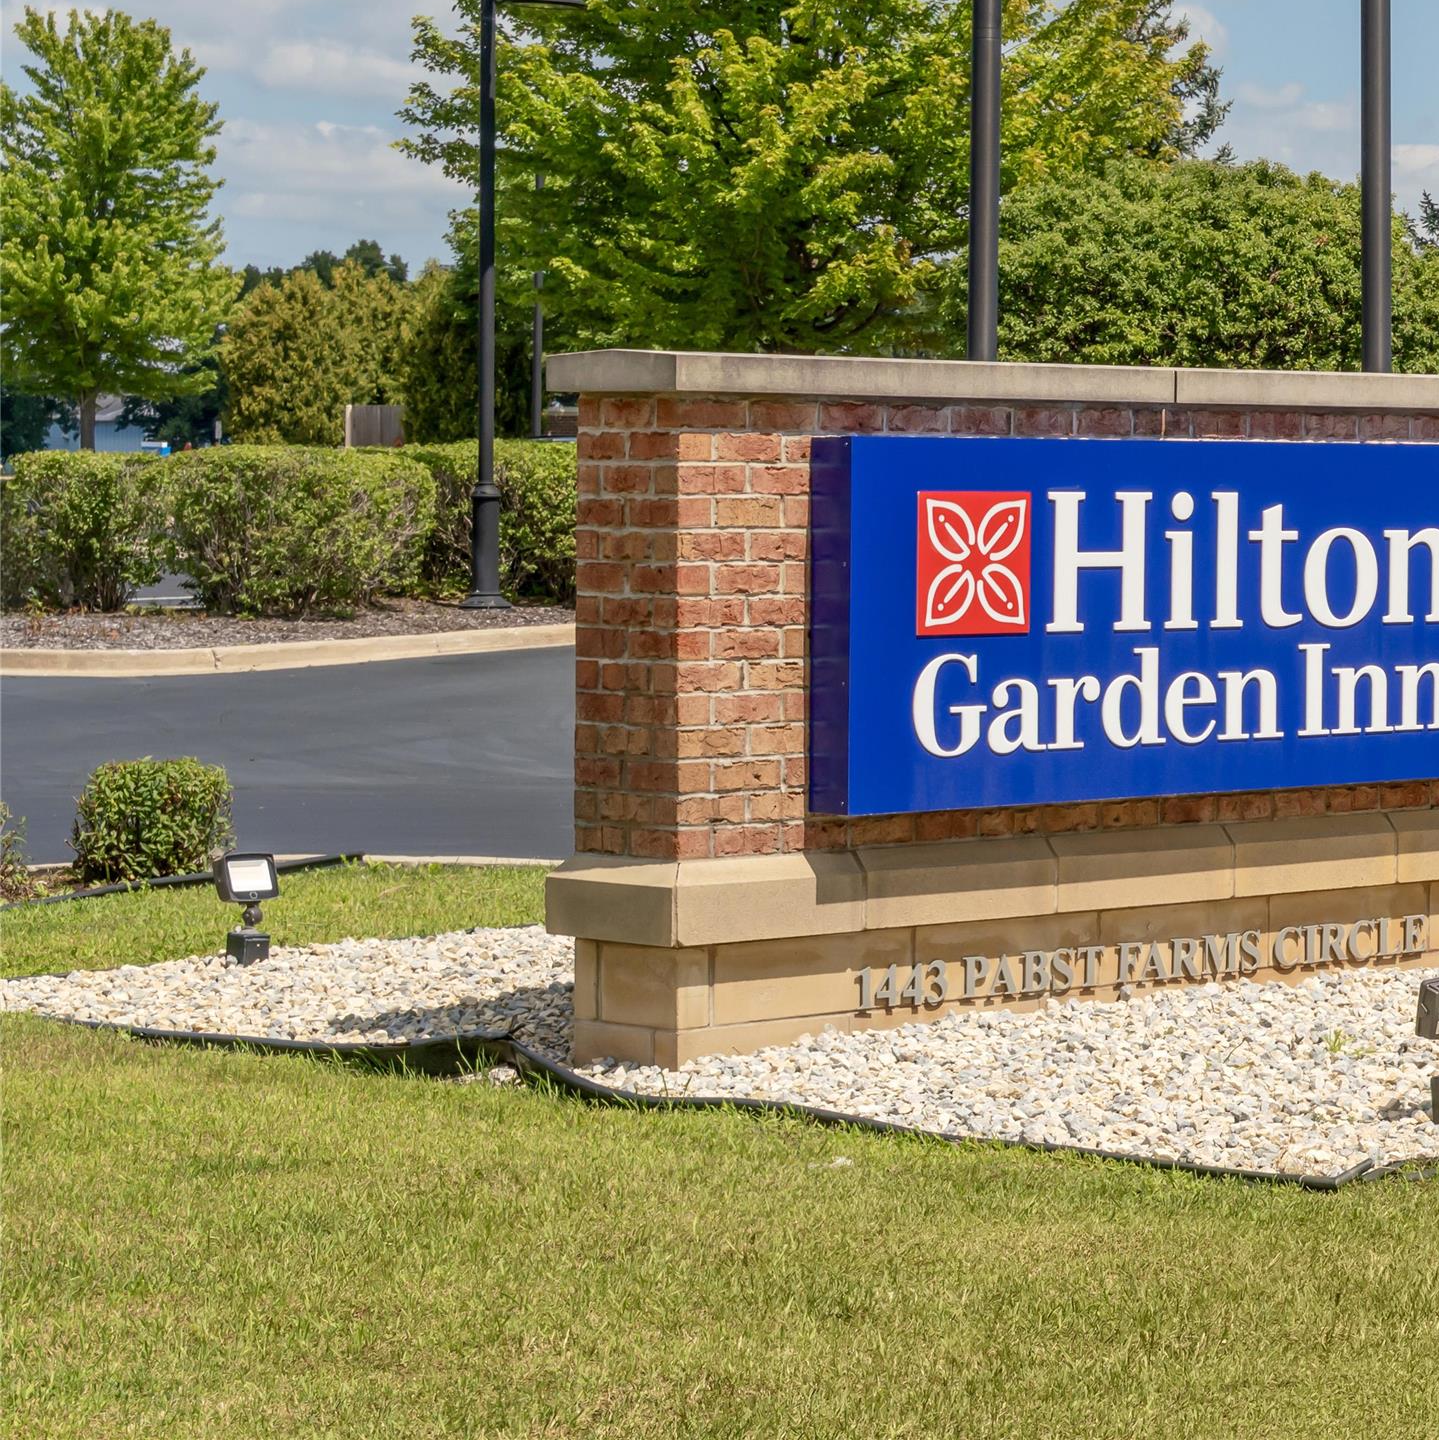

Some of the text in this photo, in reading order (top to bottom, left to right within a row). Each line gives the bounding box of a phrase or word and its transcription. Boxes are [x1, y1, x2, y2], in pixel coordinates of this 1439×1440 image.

[912, 646, 1285, 758] Garden
[856, 914, 1426, 1010] 1443 PABST FARMS CIRCLE
